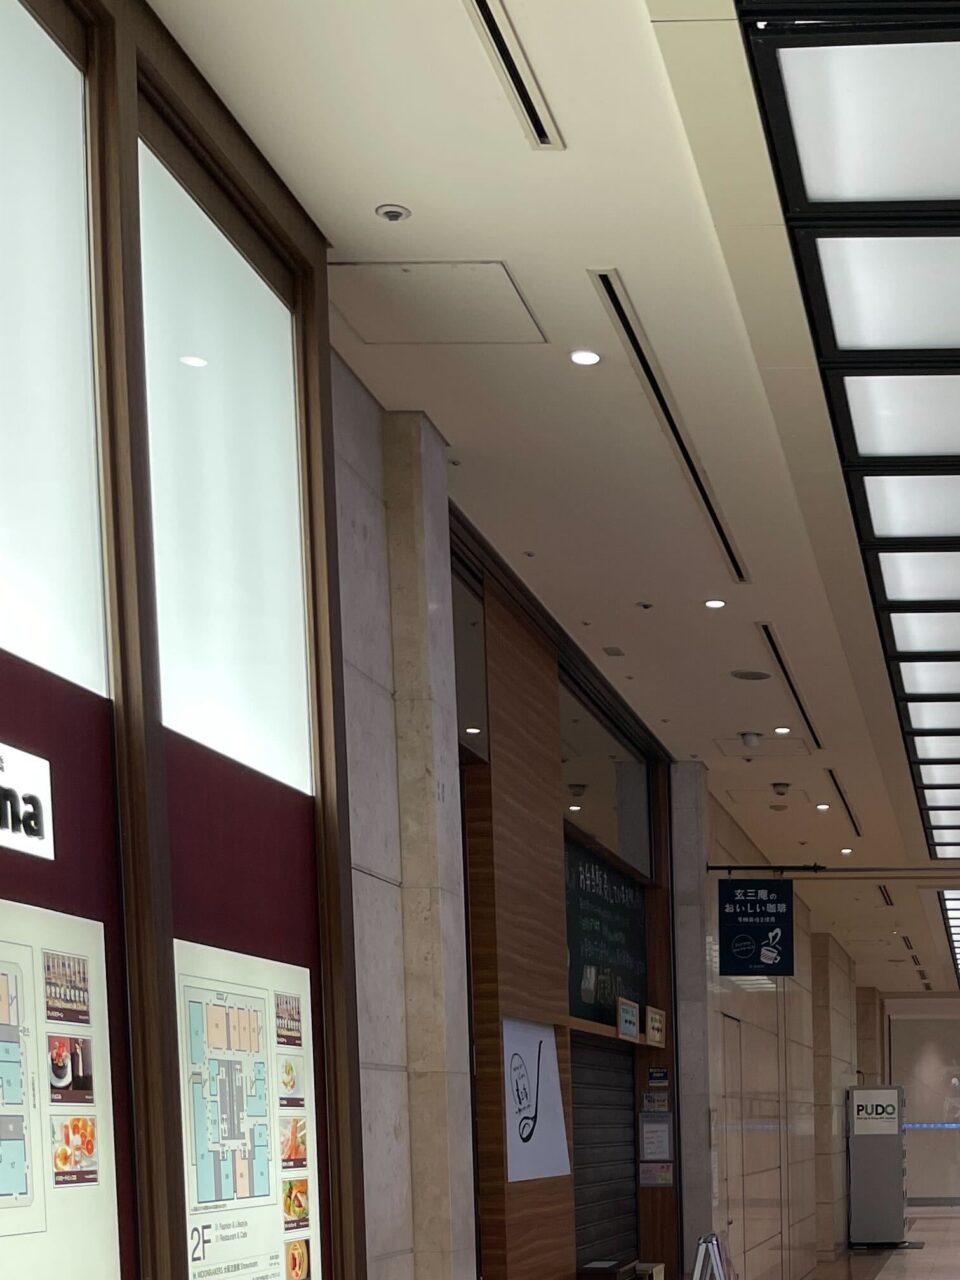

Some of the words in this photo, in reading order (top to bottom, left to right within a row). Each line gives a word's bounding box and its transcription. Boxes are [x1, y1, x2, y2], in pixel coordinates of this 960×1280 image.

[724, 903, 787, 913] おいしい珈琲
[857, 1104, 896, 1116] PUDO
[190, 1224, 212, 1262] 2F
